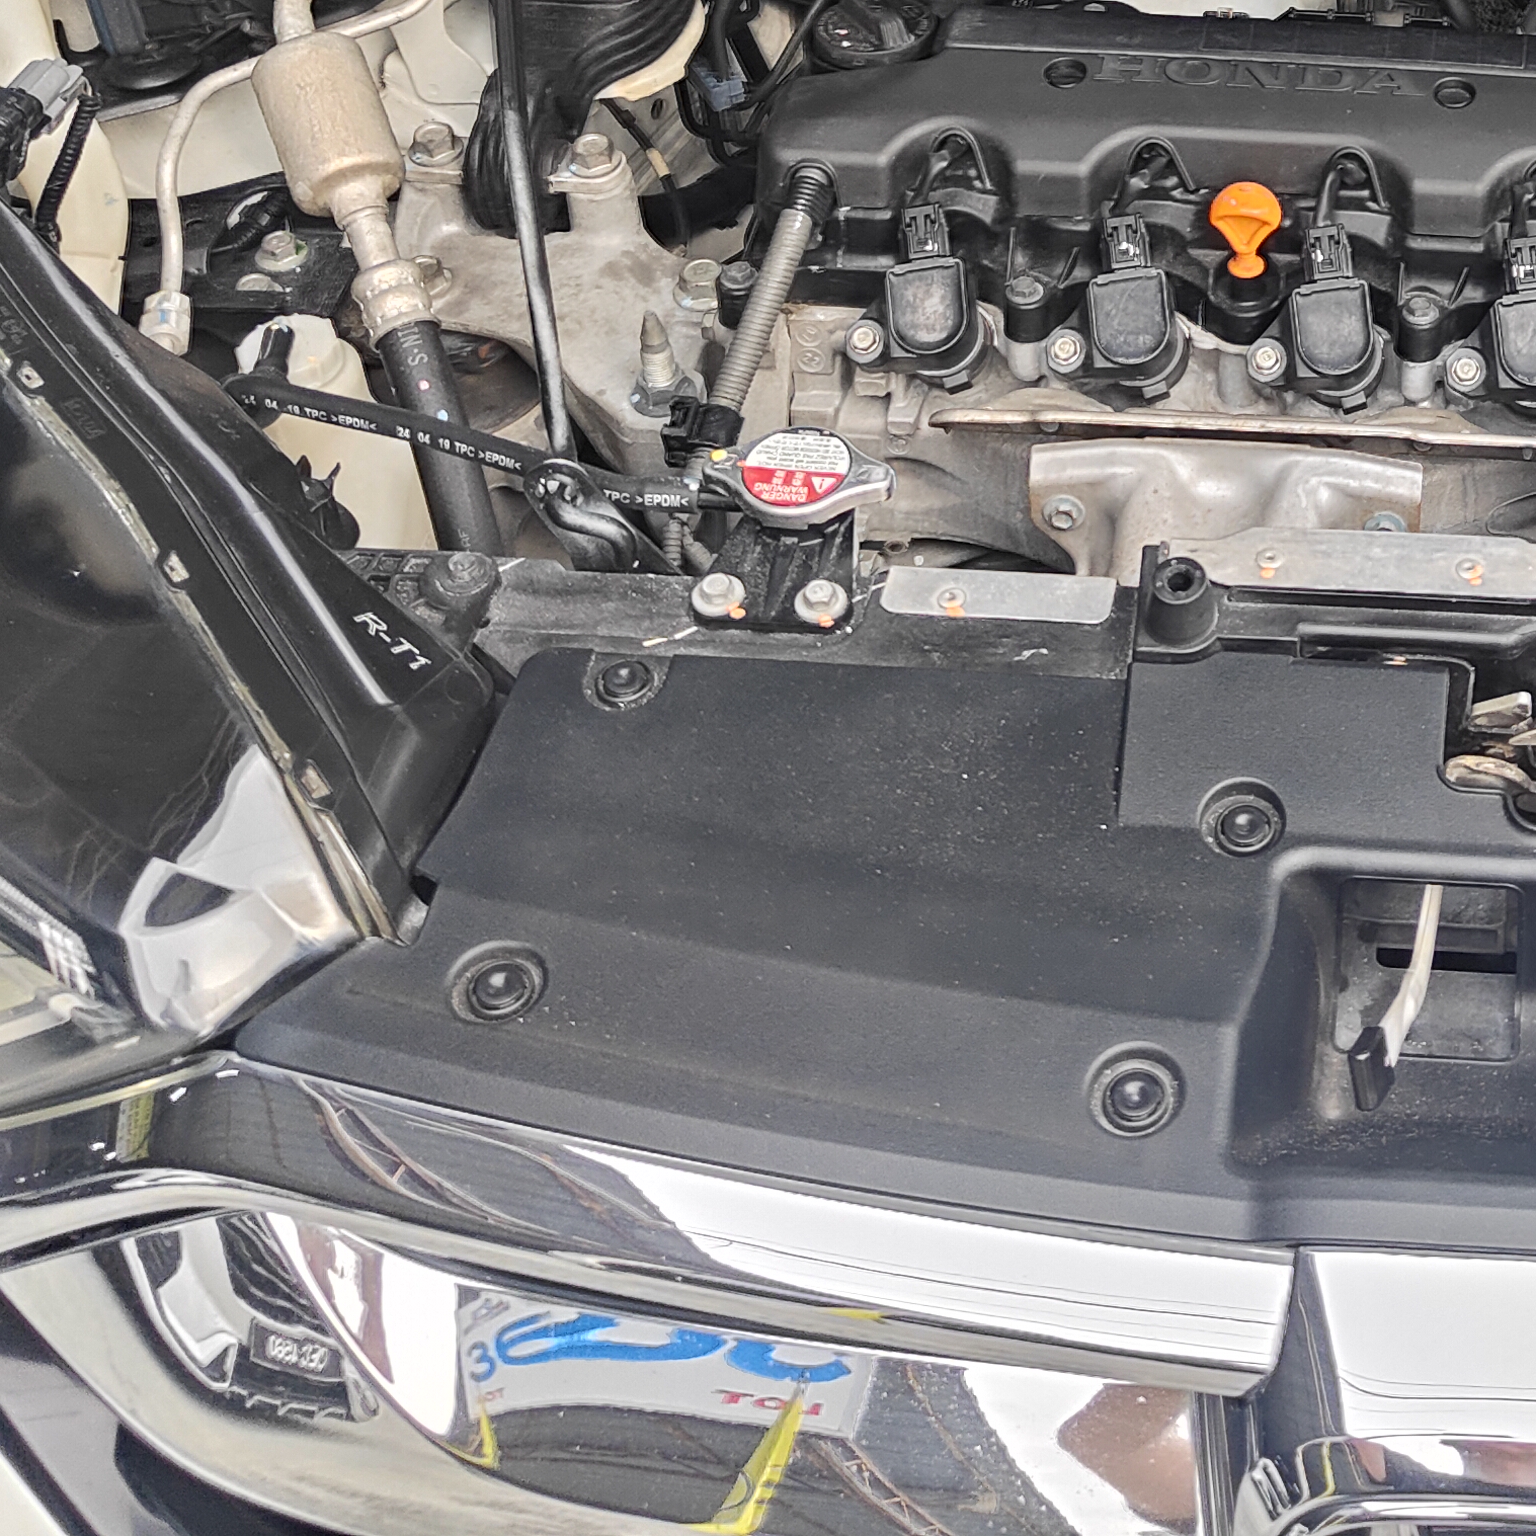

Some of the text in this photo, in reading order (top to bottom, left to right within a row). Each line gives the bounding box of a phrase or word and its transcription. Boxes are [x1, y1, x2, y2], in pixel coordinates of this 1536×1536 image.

[1092, 53, 1426, 97] HONDA
[303, 407, 328, 421] TPC
[453, 441, 475, 458] TPC
[603, 488, 631, 504] TPC
[760, 491, 807, 502] DANGER
